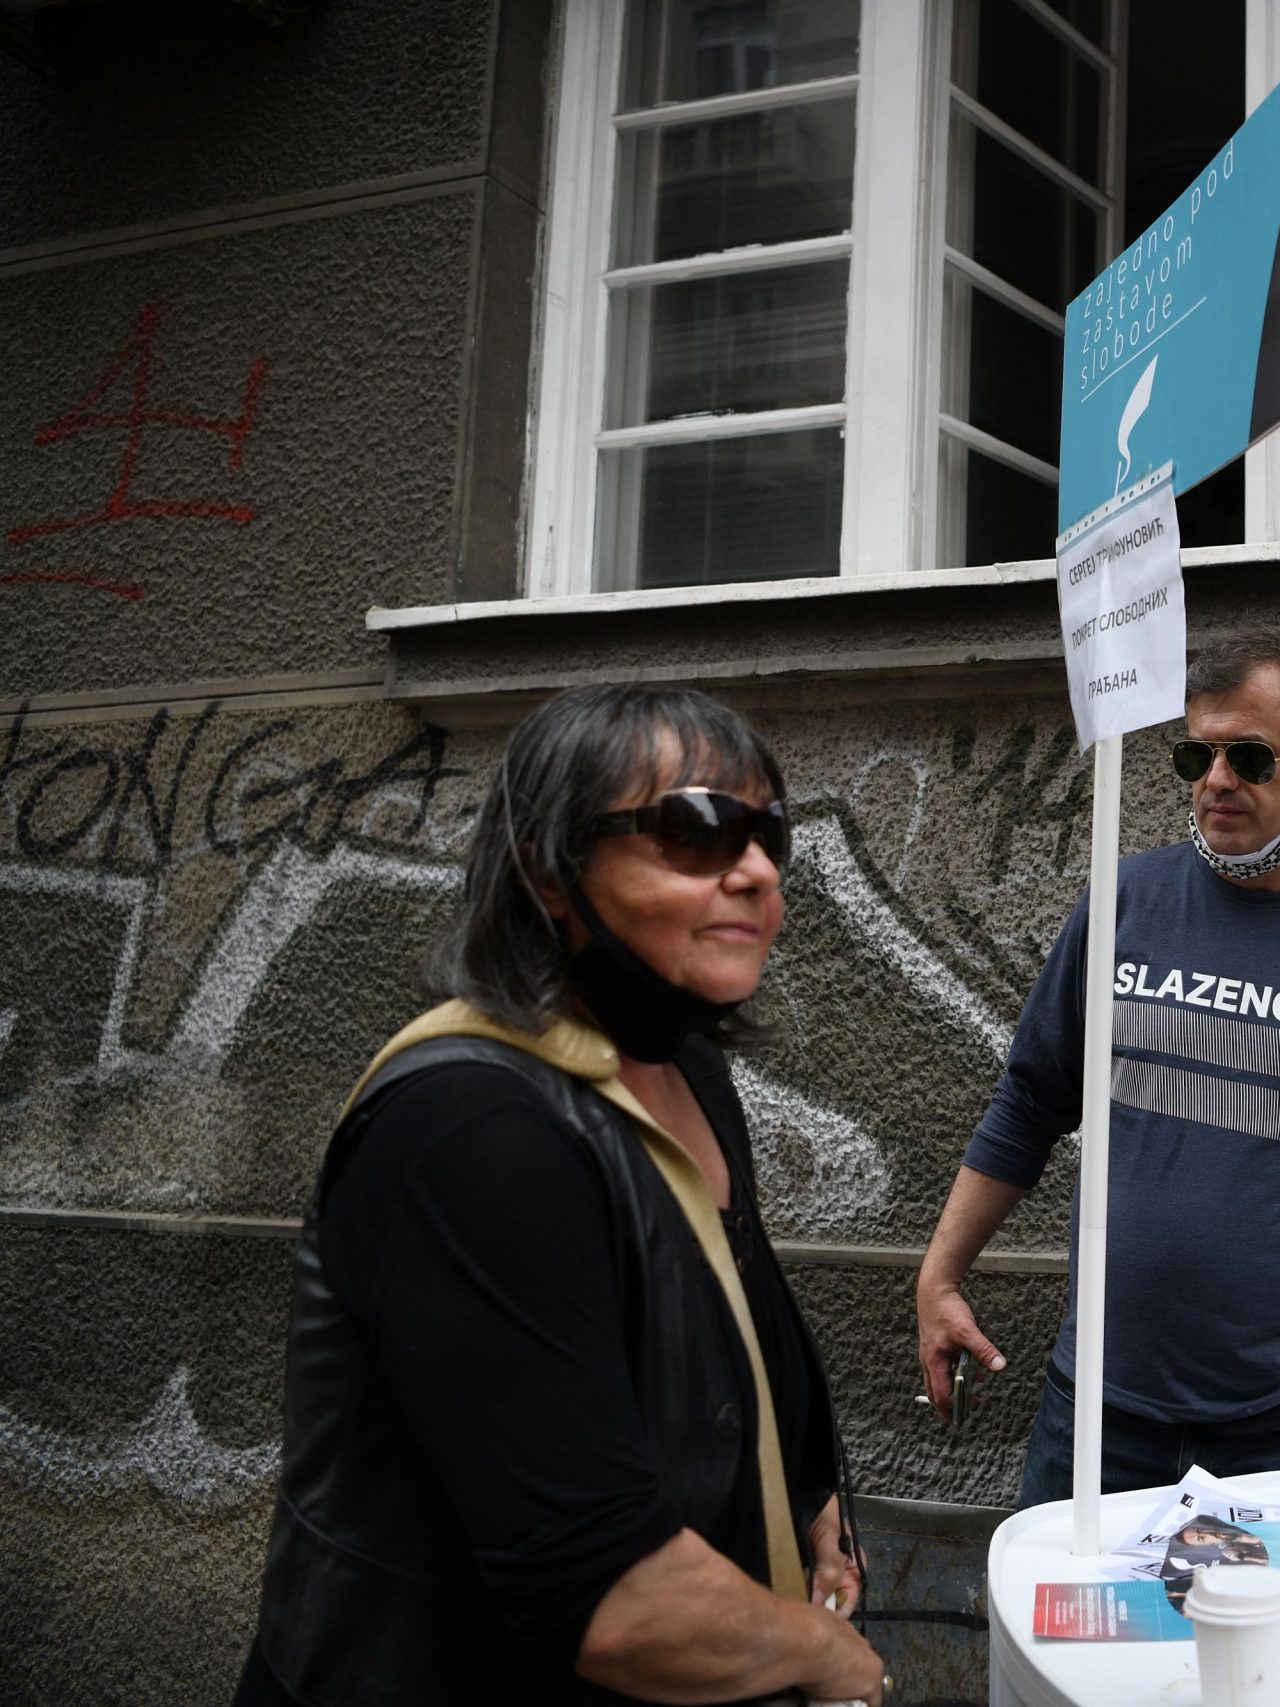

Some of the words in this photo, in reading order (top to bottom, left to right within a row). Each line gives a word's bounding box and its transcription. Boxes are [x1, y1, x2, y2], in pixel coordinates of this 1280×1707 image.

[1084, 215, 1174, 318] zajedno
[1191, 138, 1234, 224] pod
[1083, 236, 1192, 354] zastavom
[1081, 293, 1173, 389] slobode
[1069, 556, 1096, 586] СЕРГЕЈ
[1096, 517, 1165, 567] ТРИФУНОВИЋ
[1072, 618, 1096, 651] ПОКРЕТ
[1099, 587, 1168, 633] СЛОБОДНИХ
[1088, 668, 1138, 700] ГРАЂАНА
